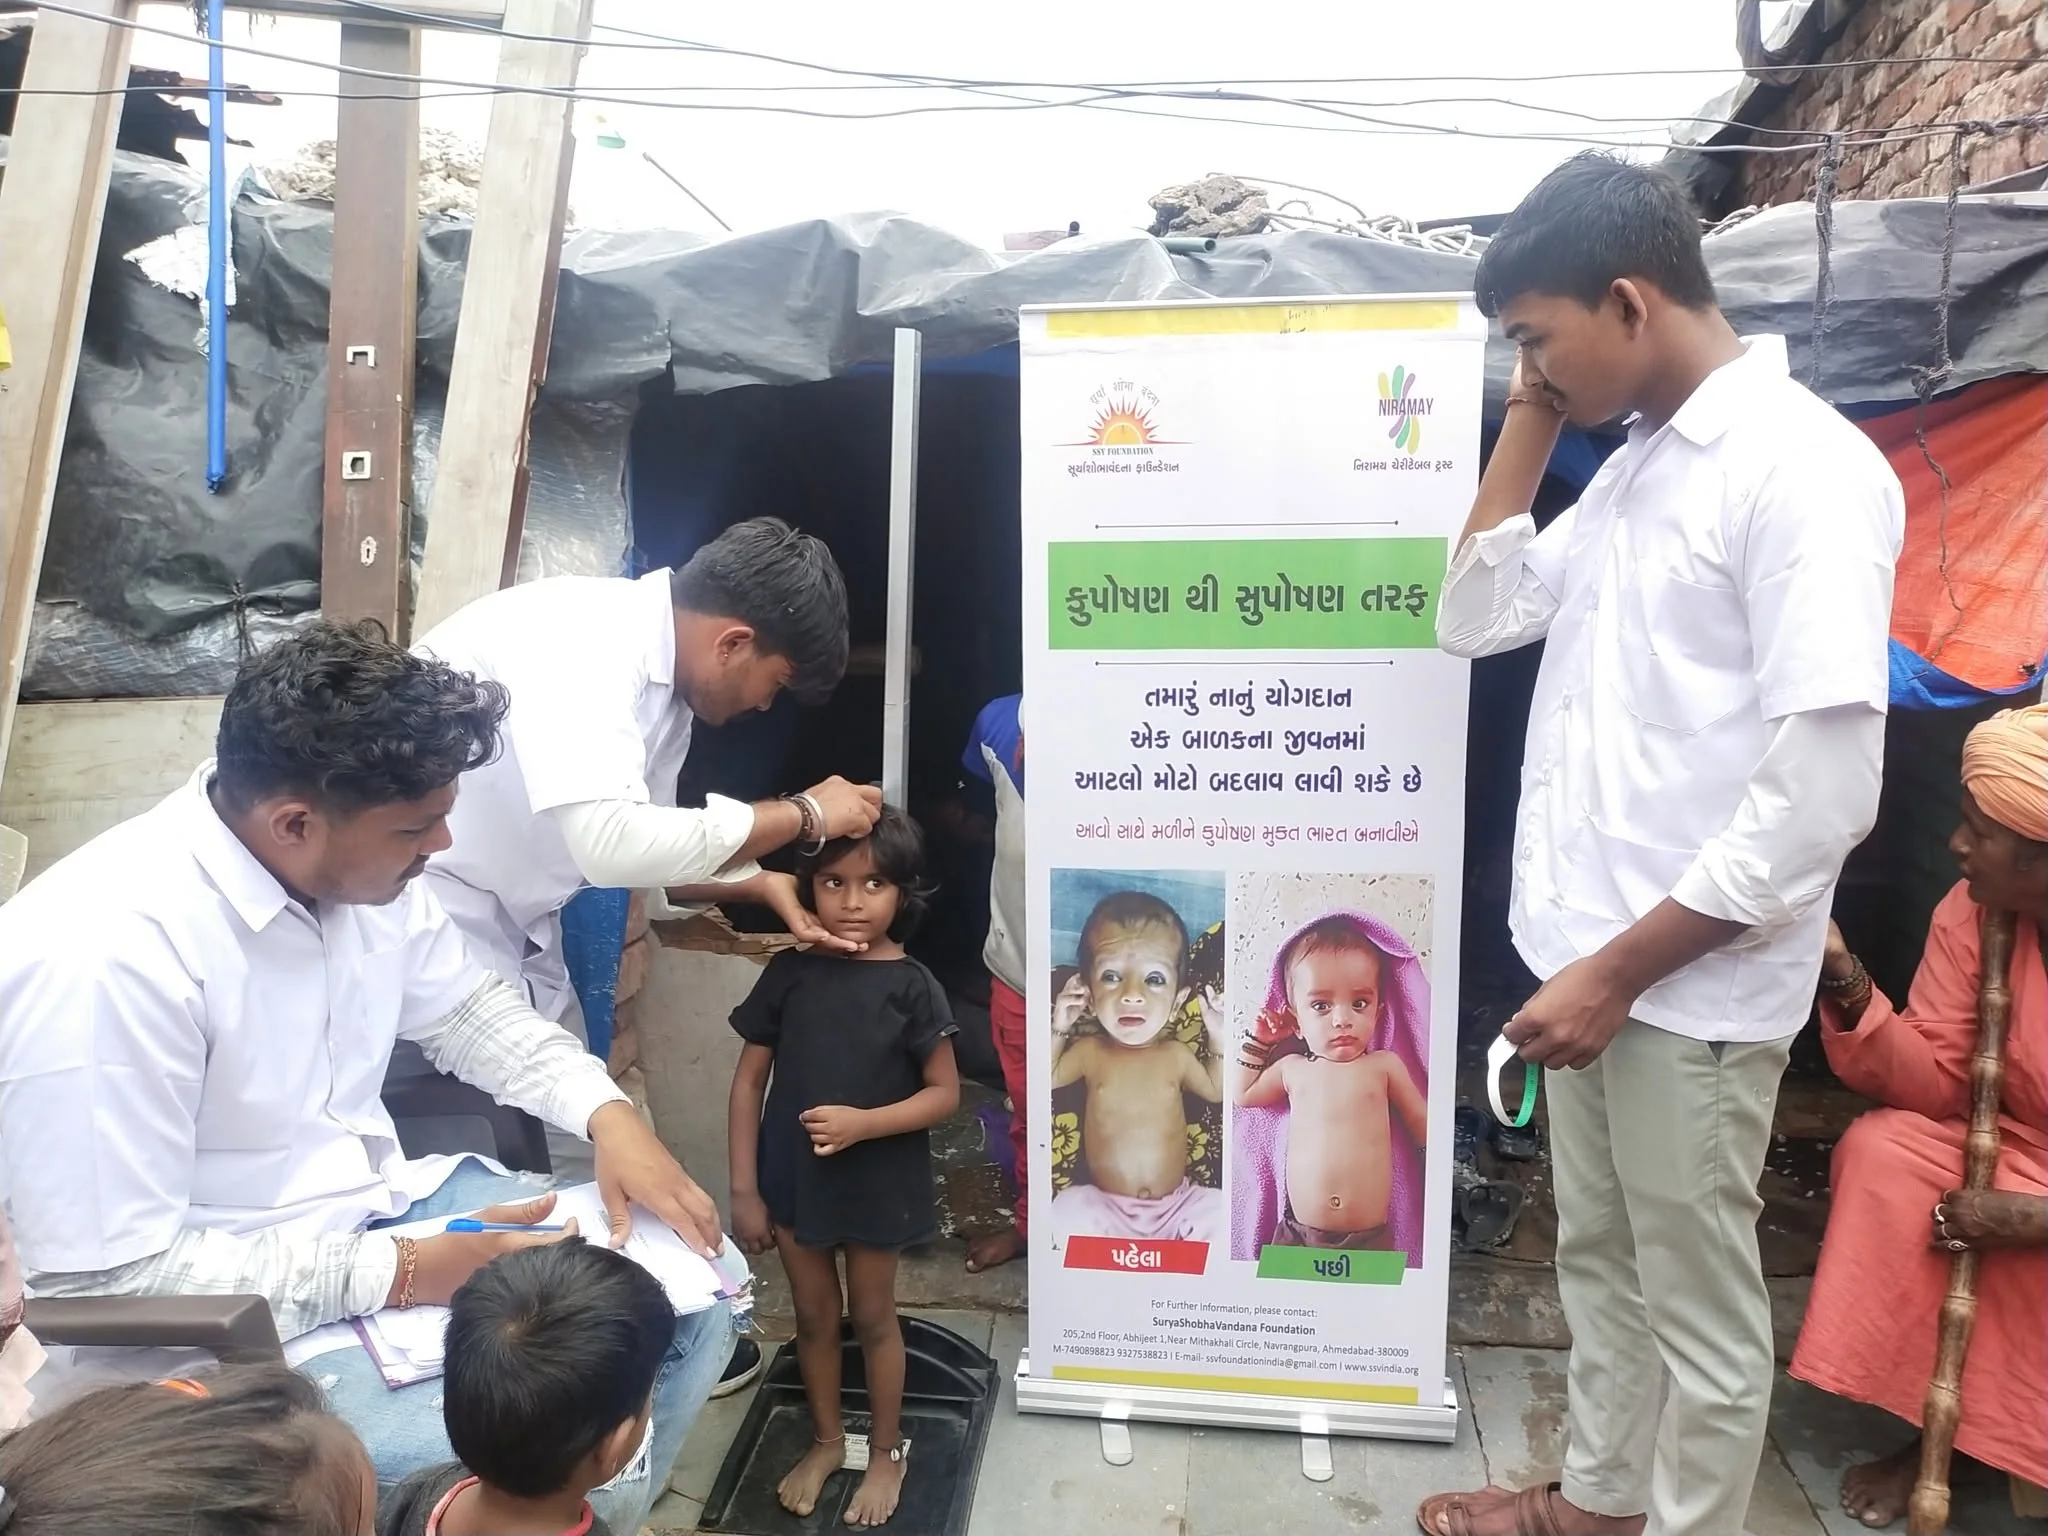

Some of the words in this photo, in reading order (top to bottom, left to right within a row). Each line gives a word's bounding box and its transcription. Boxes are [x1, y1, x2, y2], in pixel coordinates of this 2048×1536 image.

[1378, 397, 1434, 417] NIRAMAY
[1107, 447, 1154, 456] FOUNDATION
[1353, 457, 1388, 473] નિરામય
[1391, 457, 1432, 472] ચેરીટેબલ
[1065, 574, 1170, 627] કુપોષણ
[1185, 573, 1220, 613] થી
[1235, 571, 1344, 626] સુપોષણ
[1360, 582, 1429, 617] તરફ
[1144, 679, 1200, 716] તમારું
[1209, 679, 1255, 716] નાનું
[1265, 678, 1353, 708] યોગદાન
[1130, 721, 1171, 749] એક
[1182, 728, 1273, 750] બાળકના
[1284, 723, 1366, 756] જીવનમાં
[1074, 762, 1143, 791] આટલો
[1153, 762, 1198, 791] મોટો
[1209, 769, 1284, 793] બદલાવ
[1294, 765, 1344, 793] લાવી
[1354, 764, 1392, 793] શકે
[1401, 764, 1423, 793] છે
[1075, 816, 1111, 840] આવો
[1117, 816, 1146, 841] સાથે
[1151, 816, 1196, 841] મળીને
[1202, 817, 1256, 847] કુપોષણ
[1306, 825, 1348, 842] ભારત
[1354, 818, 1420, 843] બનાવીએ
[1111, 1242, 1162, 1269] પહેલા
[1313, 1253, 1351, 1279] પછી
[1151, 1299, 1165, 1309] For
[1167, 1300, 1198, 1312] Further
[1200, 1302, 1252, 1315] Information,
[1254, 1305, 1282, 1318] please
[1283, 1308, 1318, 1318] contact:
[1152, 1316, 1258, 1333] SuryaShobhaVandana
[1260, 1323, 1316, 1336] Foundation
[1063, 1329, 1096, 1340] 205,2nd
[1098, 1331, 1121, 1342] Floor,
[1123, 1334, 1158, 1345] Abhijeet
[1160, 1335, 1188, 1345] 1,Near
[1189, 1336, 1234, 1349] Mithakhali
[1235, 1339, 1262, 1351] Circle,
[1264, 1341, 1321, 1354] Navrangpura,
[1322, 1344, 1410, 1358] Ahmedabad-380009
[1053, 1344, 1115, 1357] M-7490898823
[1117, 1349, 1168, 1360] 9327538823
[1206, 1353, 1337, 1371] ssvfoundationindia@gmail.com
[1344, 1363, 1419, 1376] www.ssvindia.org
